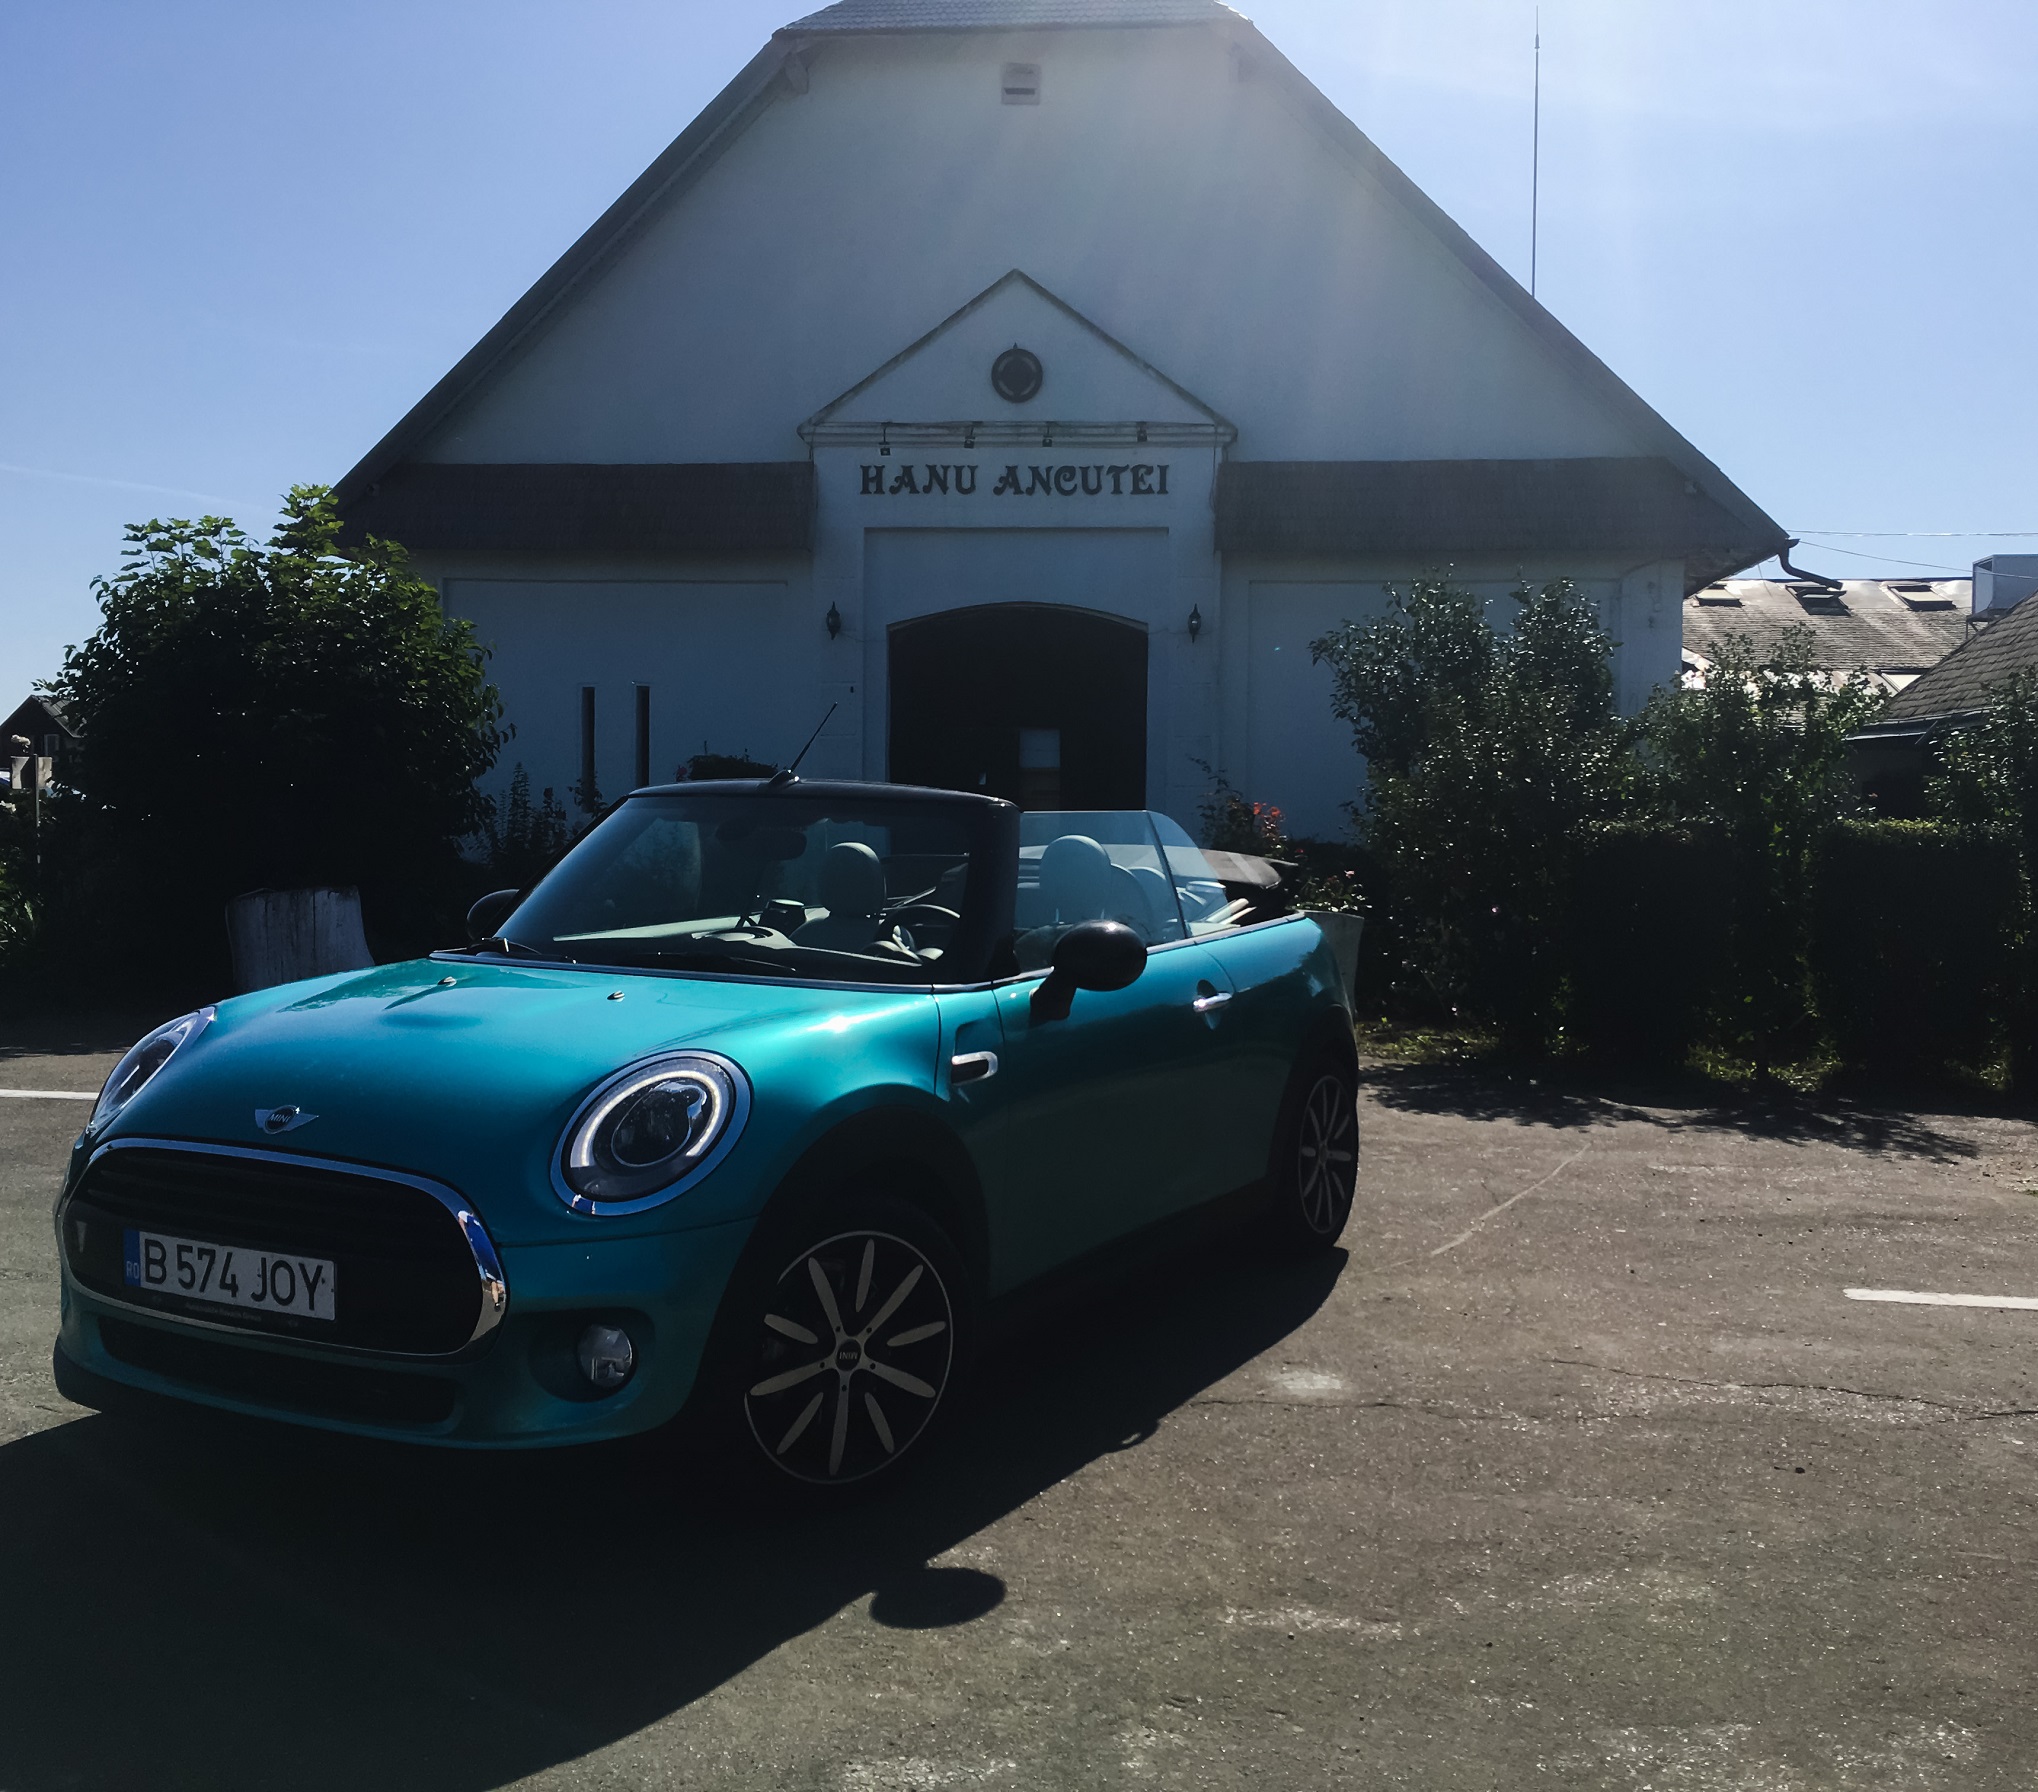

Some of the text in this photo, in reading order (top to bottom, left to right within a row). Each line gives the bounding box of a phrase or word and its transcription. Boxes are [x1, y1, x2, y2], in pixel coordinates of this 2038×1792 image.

[860, 463, 1169, 496] HANU ANCUTEI
[270, 1113, 290, 1122] MINI
[126, 1260, 140, 1280] RO
[144, 1238, 323, 1311] B 574 JOY
